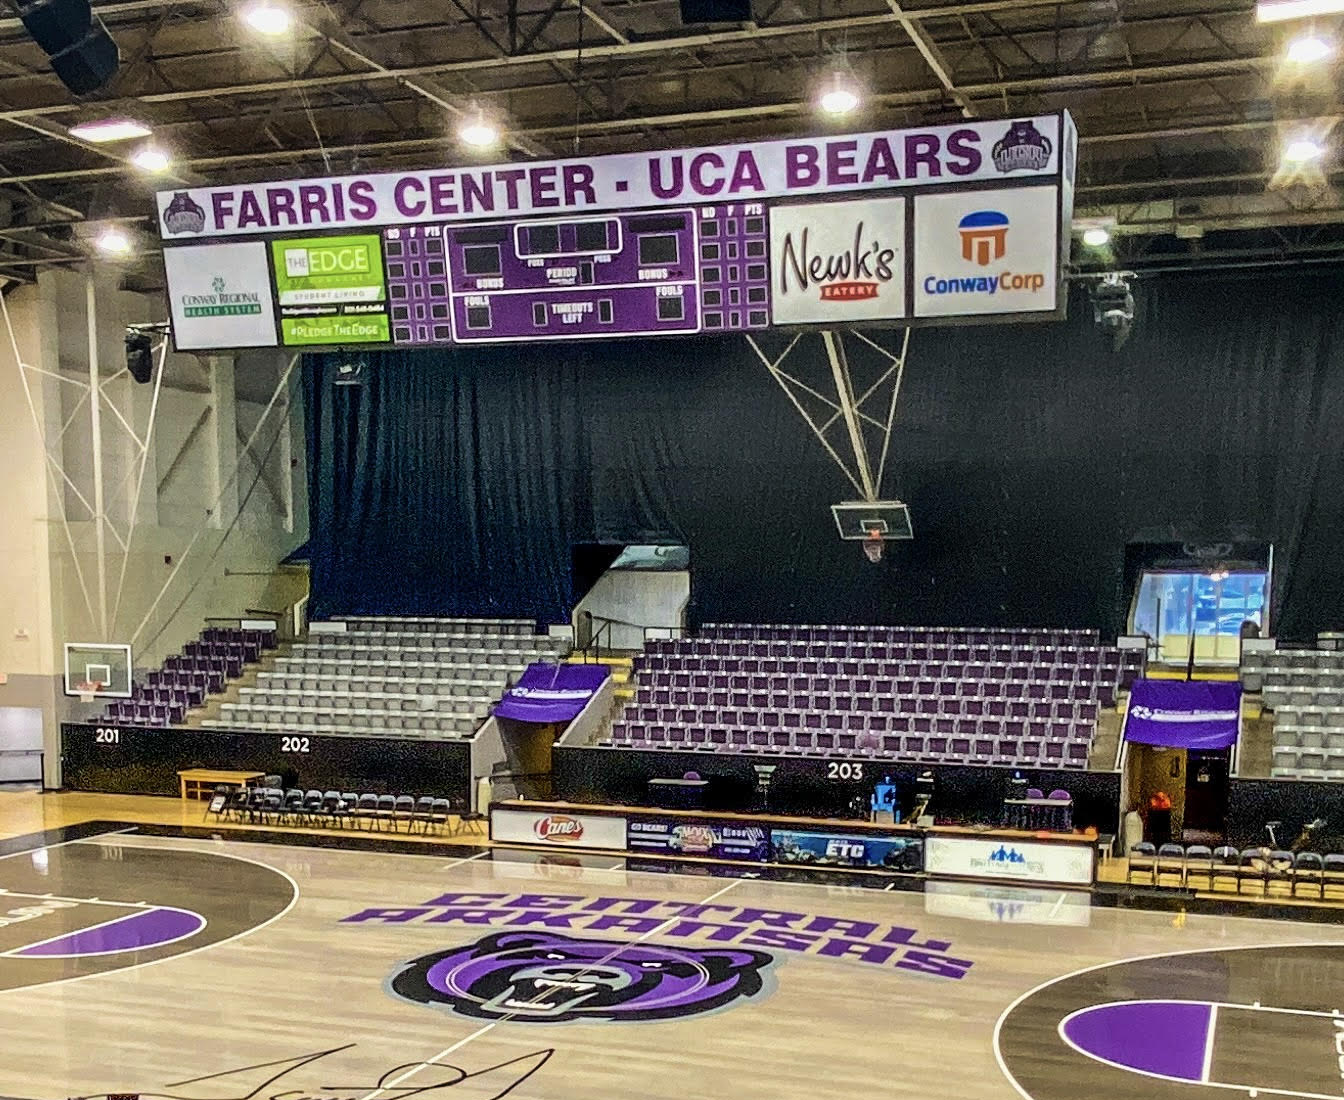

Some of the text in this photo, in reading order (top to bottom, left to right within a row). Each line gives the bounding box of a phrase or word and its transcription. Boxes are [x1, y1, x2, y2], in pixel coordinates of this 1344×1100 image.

[211, 180, 377, 230] FARRIS
[394, 163, 597, 217] CENTER
[648, 150, 767, 199] UCA
[786, 129, 982, 189] BEARS
[744, 204, 762, 215] PTS
[288, 249, 368, 272] THE EDGE
[780, 221, 895, 295] Newk's
[546, 267, 577, 278] PERIOD
[656, 285, 683, 296] FOULS
[824, 285, 874, 297] EATERY
[924, 272, 1044, 296] ConwayCorp
[551, 302, 594, 314] TIMEOUTS
[562, 313, 584, 324] LEFT
[96, 729, 119, 744] 201
[281, 737, 310, 752] 202
[828, 762, 863, 780] 203
[826, 843, 865, 858] ETC
[419, 892, 953, 952] CENTRAL
[337, 907, 975, 980] ARKANSAS
